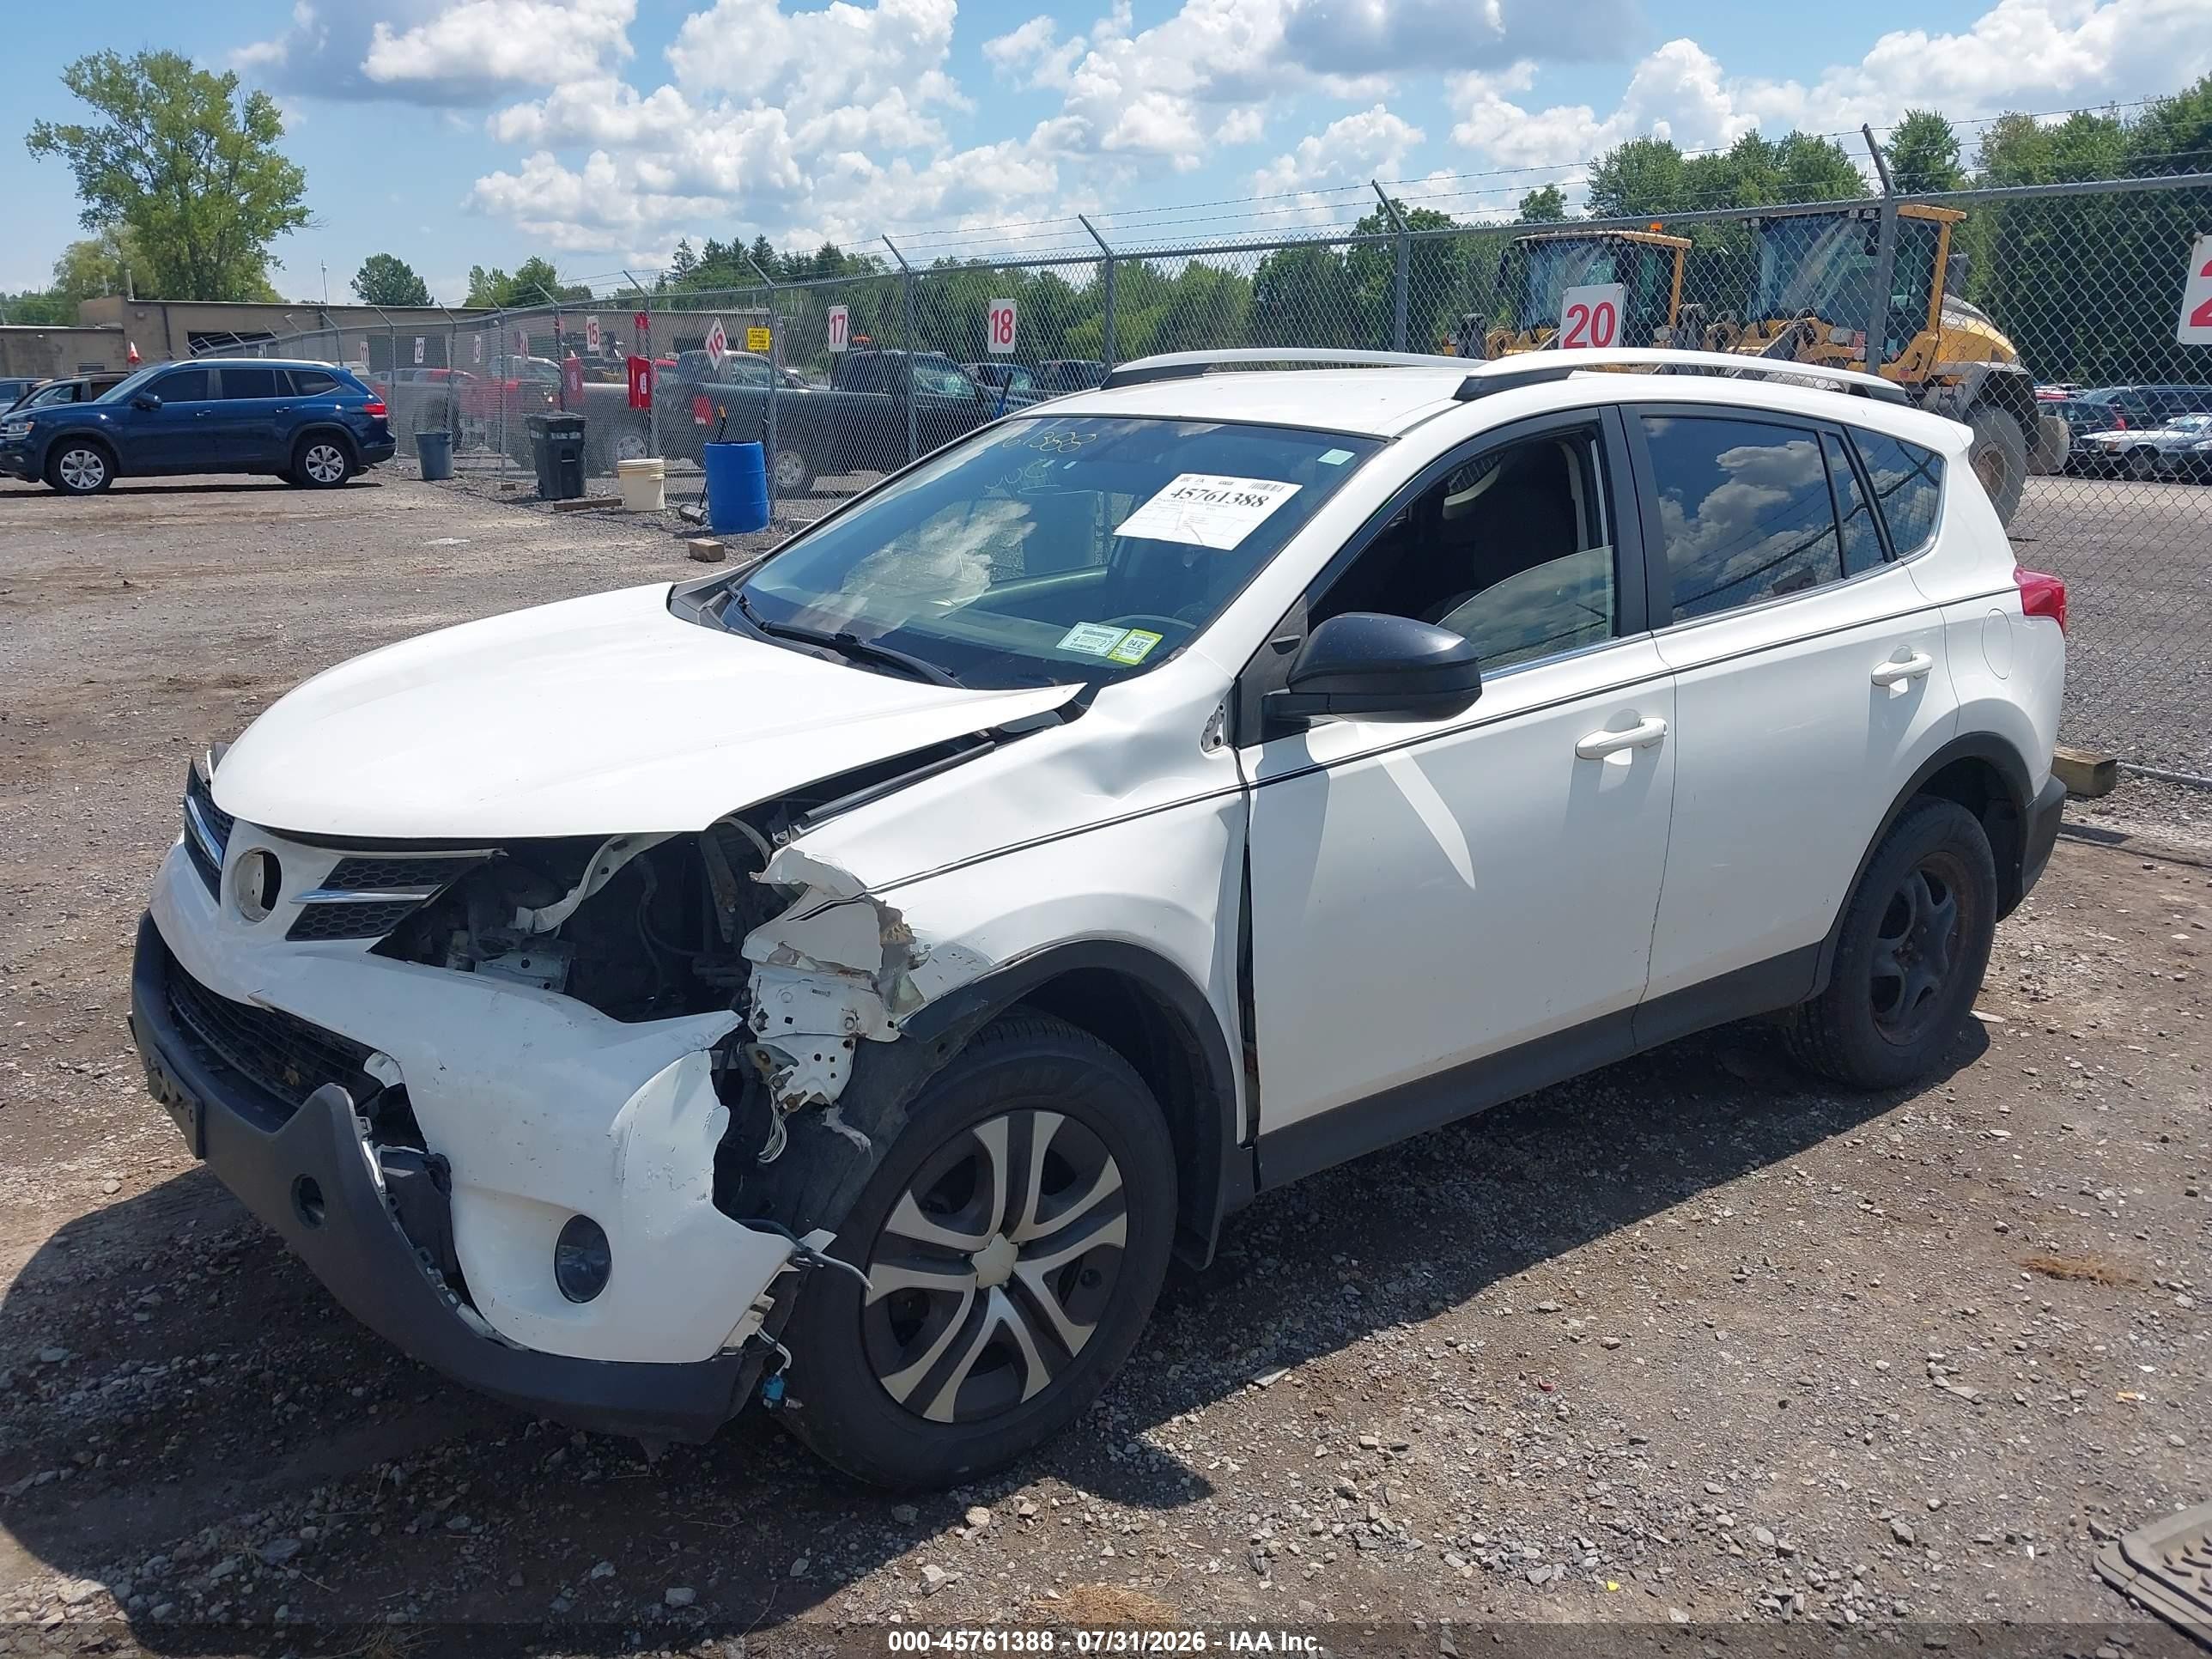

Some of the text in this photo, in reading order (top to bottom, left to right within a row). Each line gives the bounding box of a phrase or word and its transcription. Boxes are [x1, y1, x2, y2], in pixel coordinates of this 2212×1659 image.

[587, 322, 599, 345] 15
[830, 314, 845, 343] 17
[991, 308, 1013, 344] 18
[1563, 302, 1616, 349] 20
[416, 339, 423, 359] 12
[708, 327, 723, 360] 16
[1170, 487, 1270, 507] 45761388
